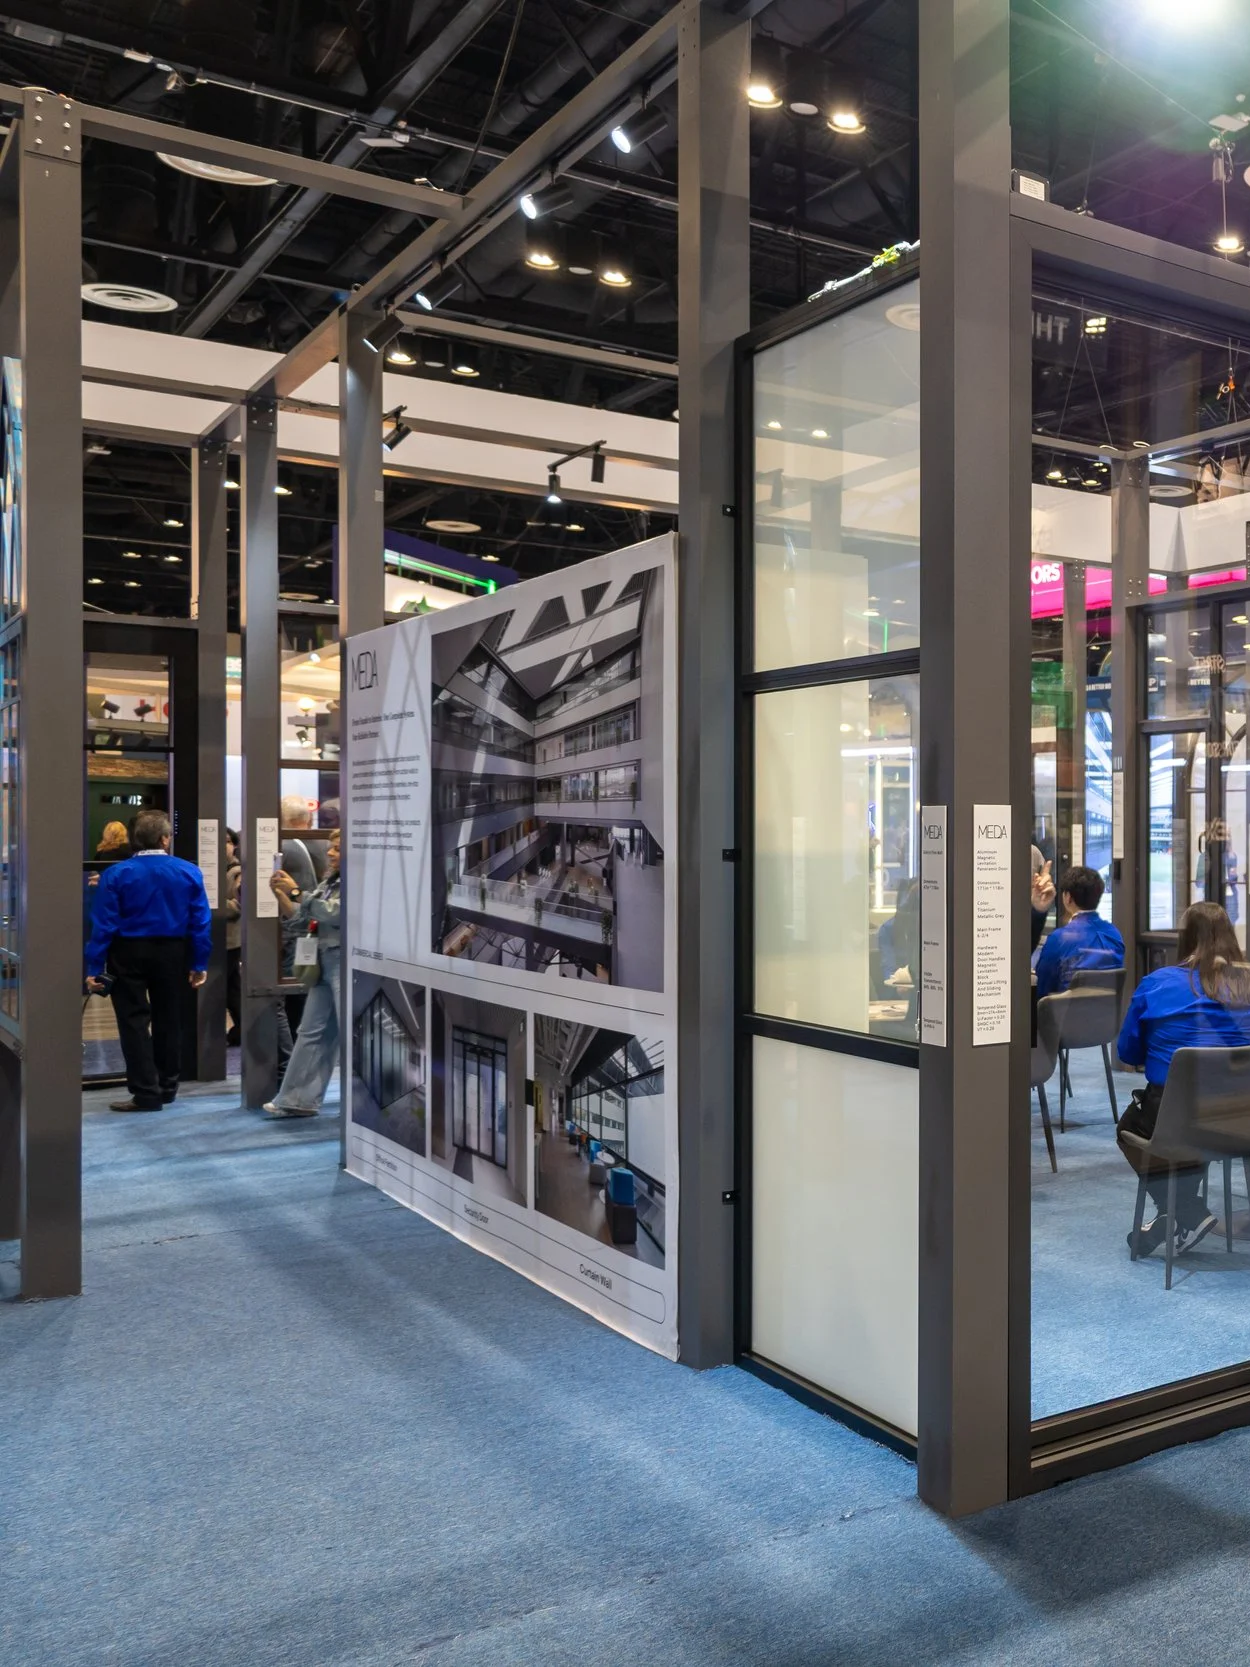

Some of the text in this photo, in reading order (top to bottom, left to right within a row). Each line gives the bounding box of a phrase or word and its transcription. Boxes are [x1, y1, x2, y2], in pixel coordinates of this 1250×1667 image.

[352, 649, 379, 693] MEDA
[924, 825, 943, 839] MEDA
[978, 824, 1008, 839] MEDA
